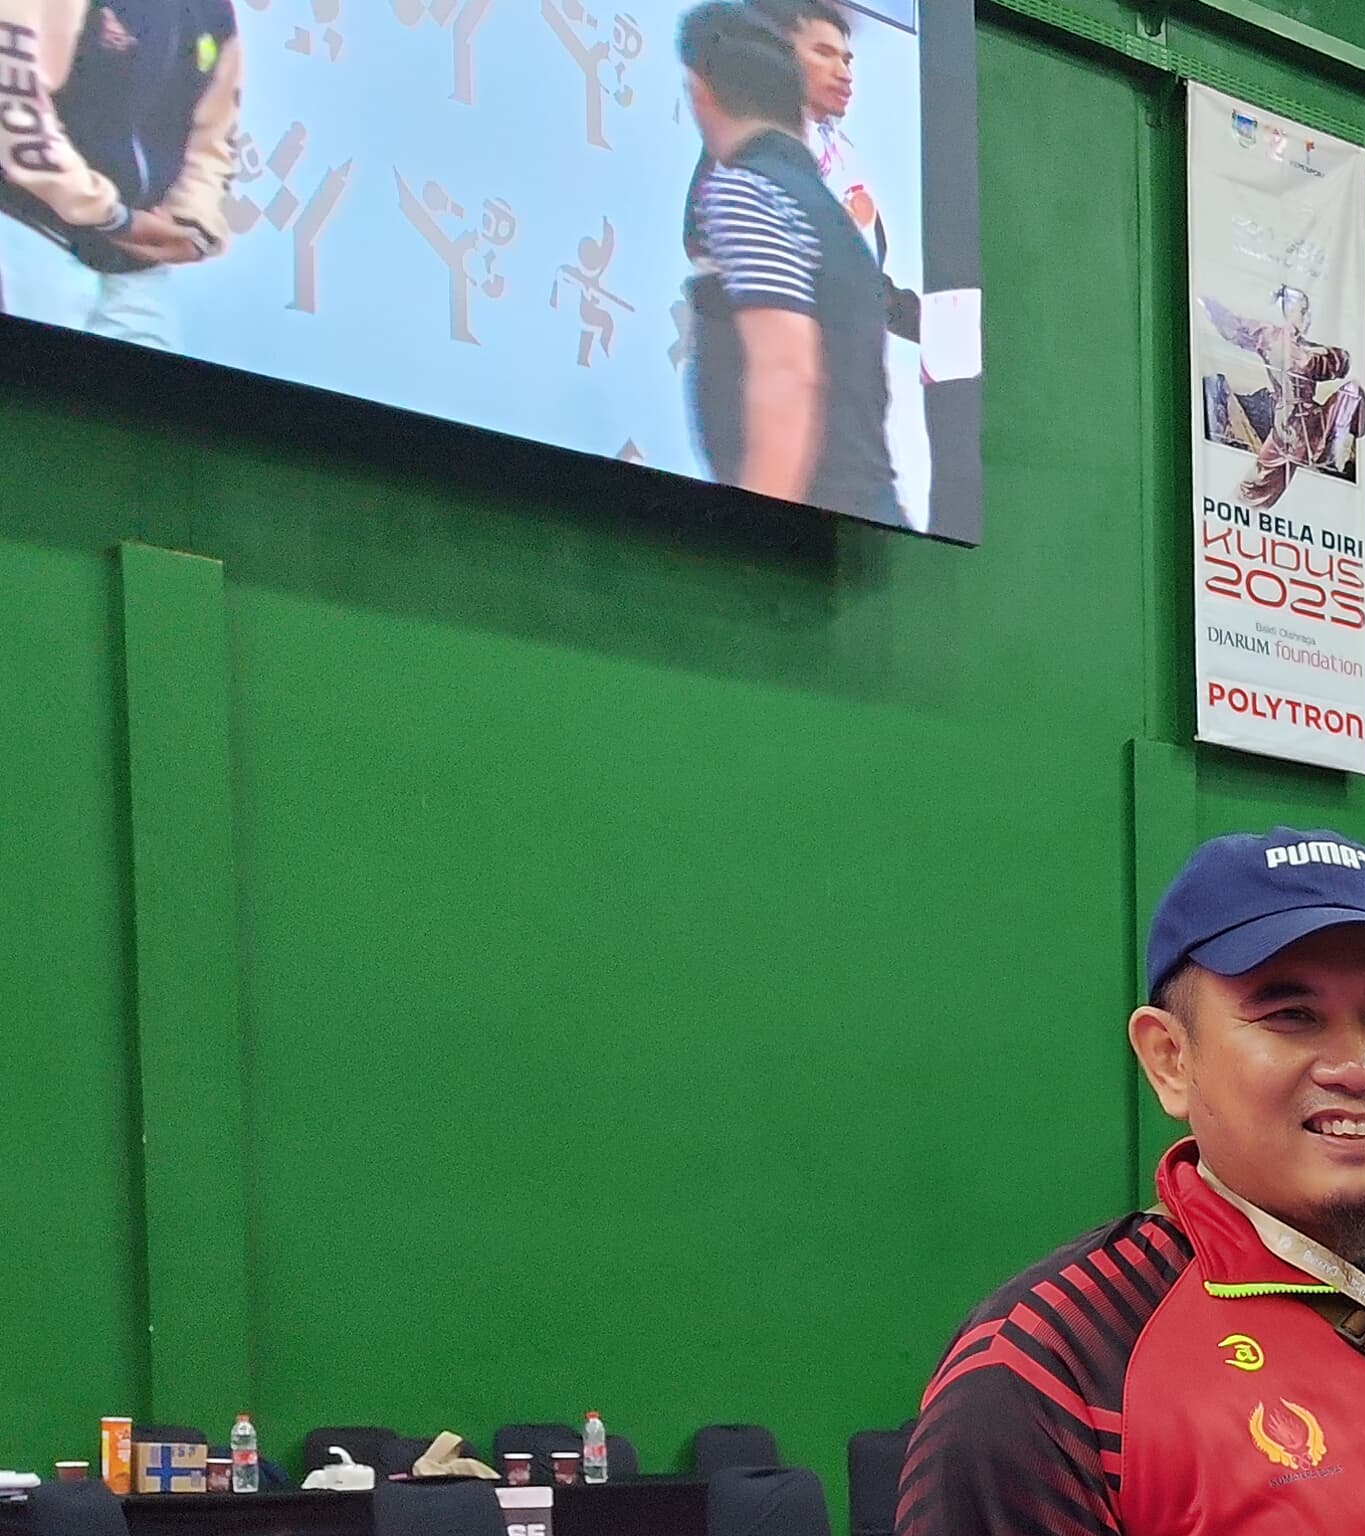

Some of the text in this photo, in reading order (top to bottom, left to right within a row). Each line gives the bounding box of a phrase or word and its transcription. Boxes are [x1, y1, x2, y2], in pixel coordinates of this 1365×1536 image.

[0, 22, 64, 173] ACEH
[1203, 520, 1364, 588] KUDUS
[1204, 497, 1362, 558] PON BELA DIRI
[1205, 555, 1365, 628] 2025
[1208, 627, 1362, 677] DJARUM foundation
[1209, 682, 1363, 739] POLYTRON
[1266, 842, 1361, 869] PUMA
